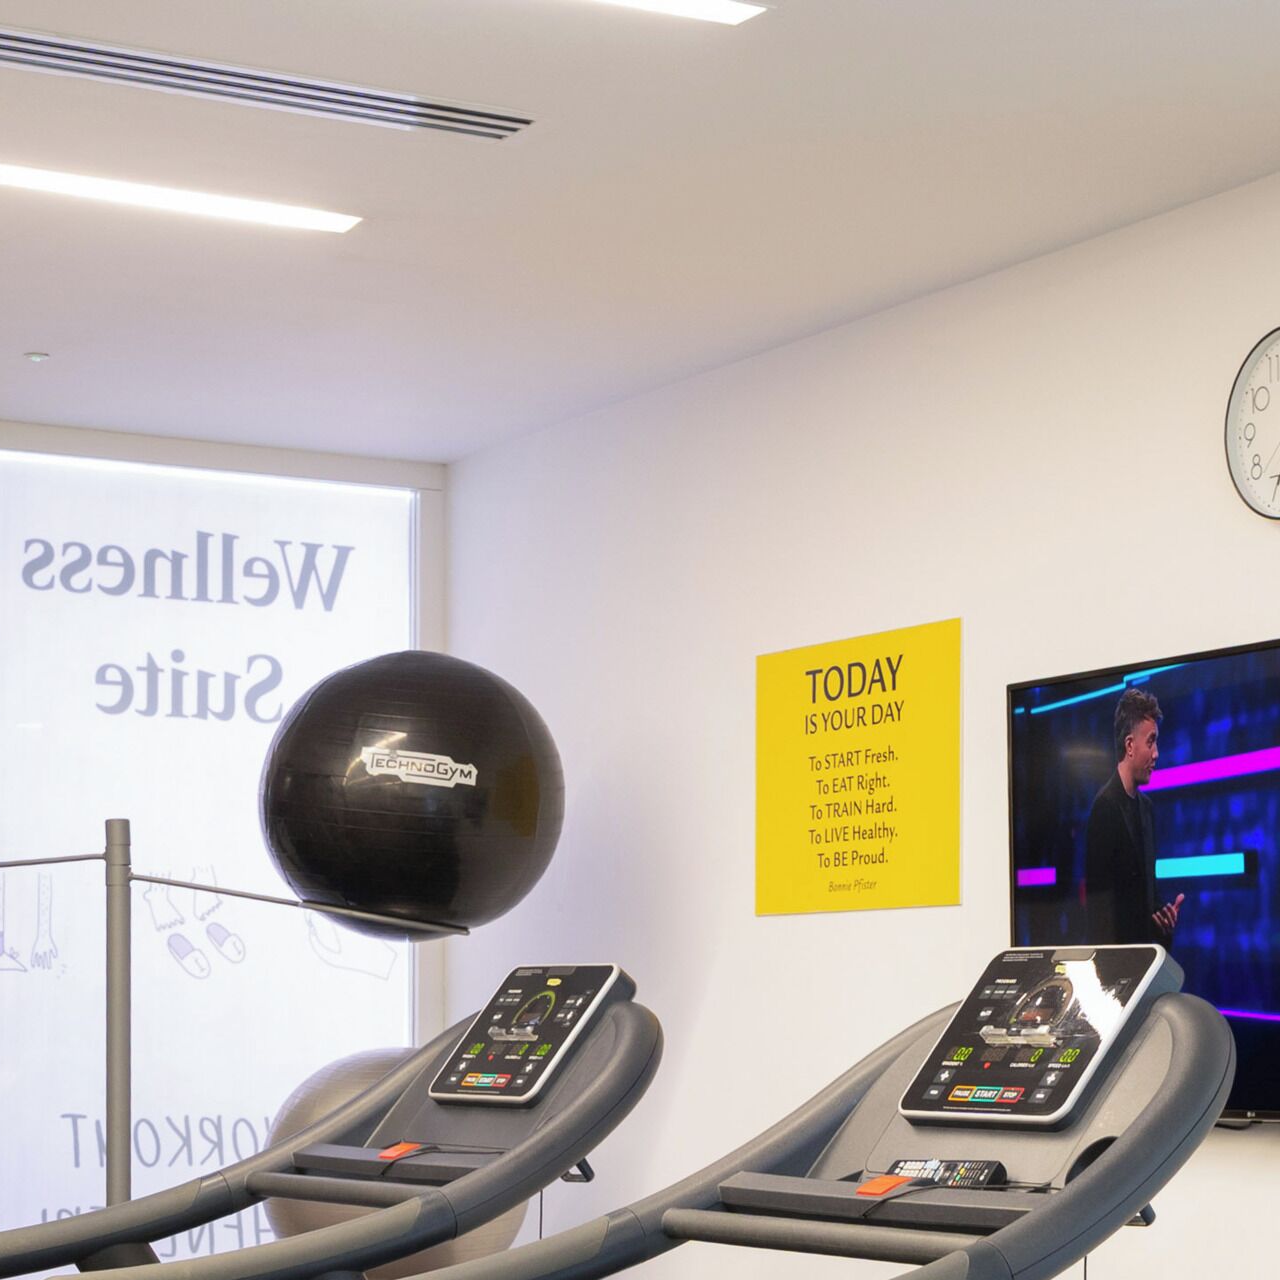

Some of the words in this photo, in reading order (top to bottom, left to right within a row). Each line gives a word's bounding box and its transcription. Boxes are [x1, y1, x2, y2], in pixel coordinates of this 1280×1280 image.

[1268, 354, 1280, 383] 11
[1251, 385, 1270, 415] 10
[1243, 423, 1256, 448] 9
[1250, 453, 1263, 480] 8
[1270, 474, 1280, 503] 7
[805, 654, 903, 704] TODAY
[805, 713, 818, 735] IS
[821, 706, 867, 732] YOUR
[871, 699, 904, 725] DAY
[370, 753, 473, 780] TECHNOGYM
[808, 755, 822, 771] To
[824, 750, 862, 770] START
[864, 744, 898, 764] Fresh.
[816, 779, 829, 795] To
[832, 775, 854, 793] EAT
[856, 771, 890, 795] Right.
[809, 804, 823, 820] To
[825, 800, 862, 819] TRAIN
[865, 795, 897, 815] Hard.
[808, 829, 822, 845] To
[824, 825, 849, 843] LIVE
[852, 821, 898, 843] Healthy.
[817, 853, 831, 868] To
[833, 851, 848, 867] BE
[851, 847, 888, 865] Proud.
[974, 1089, 998, 1099] START
